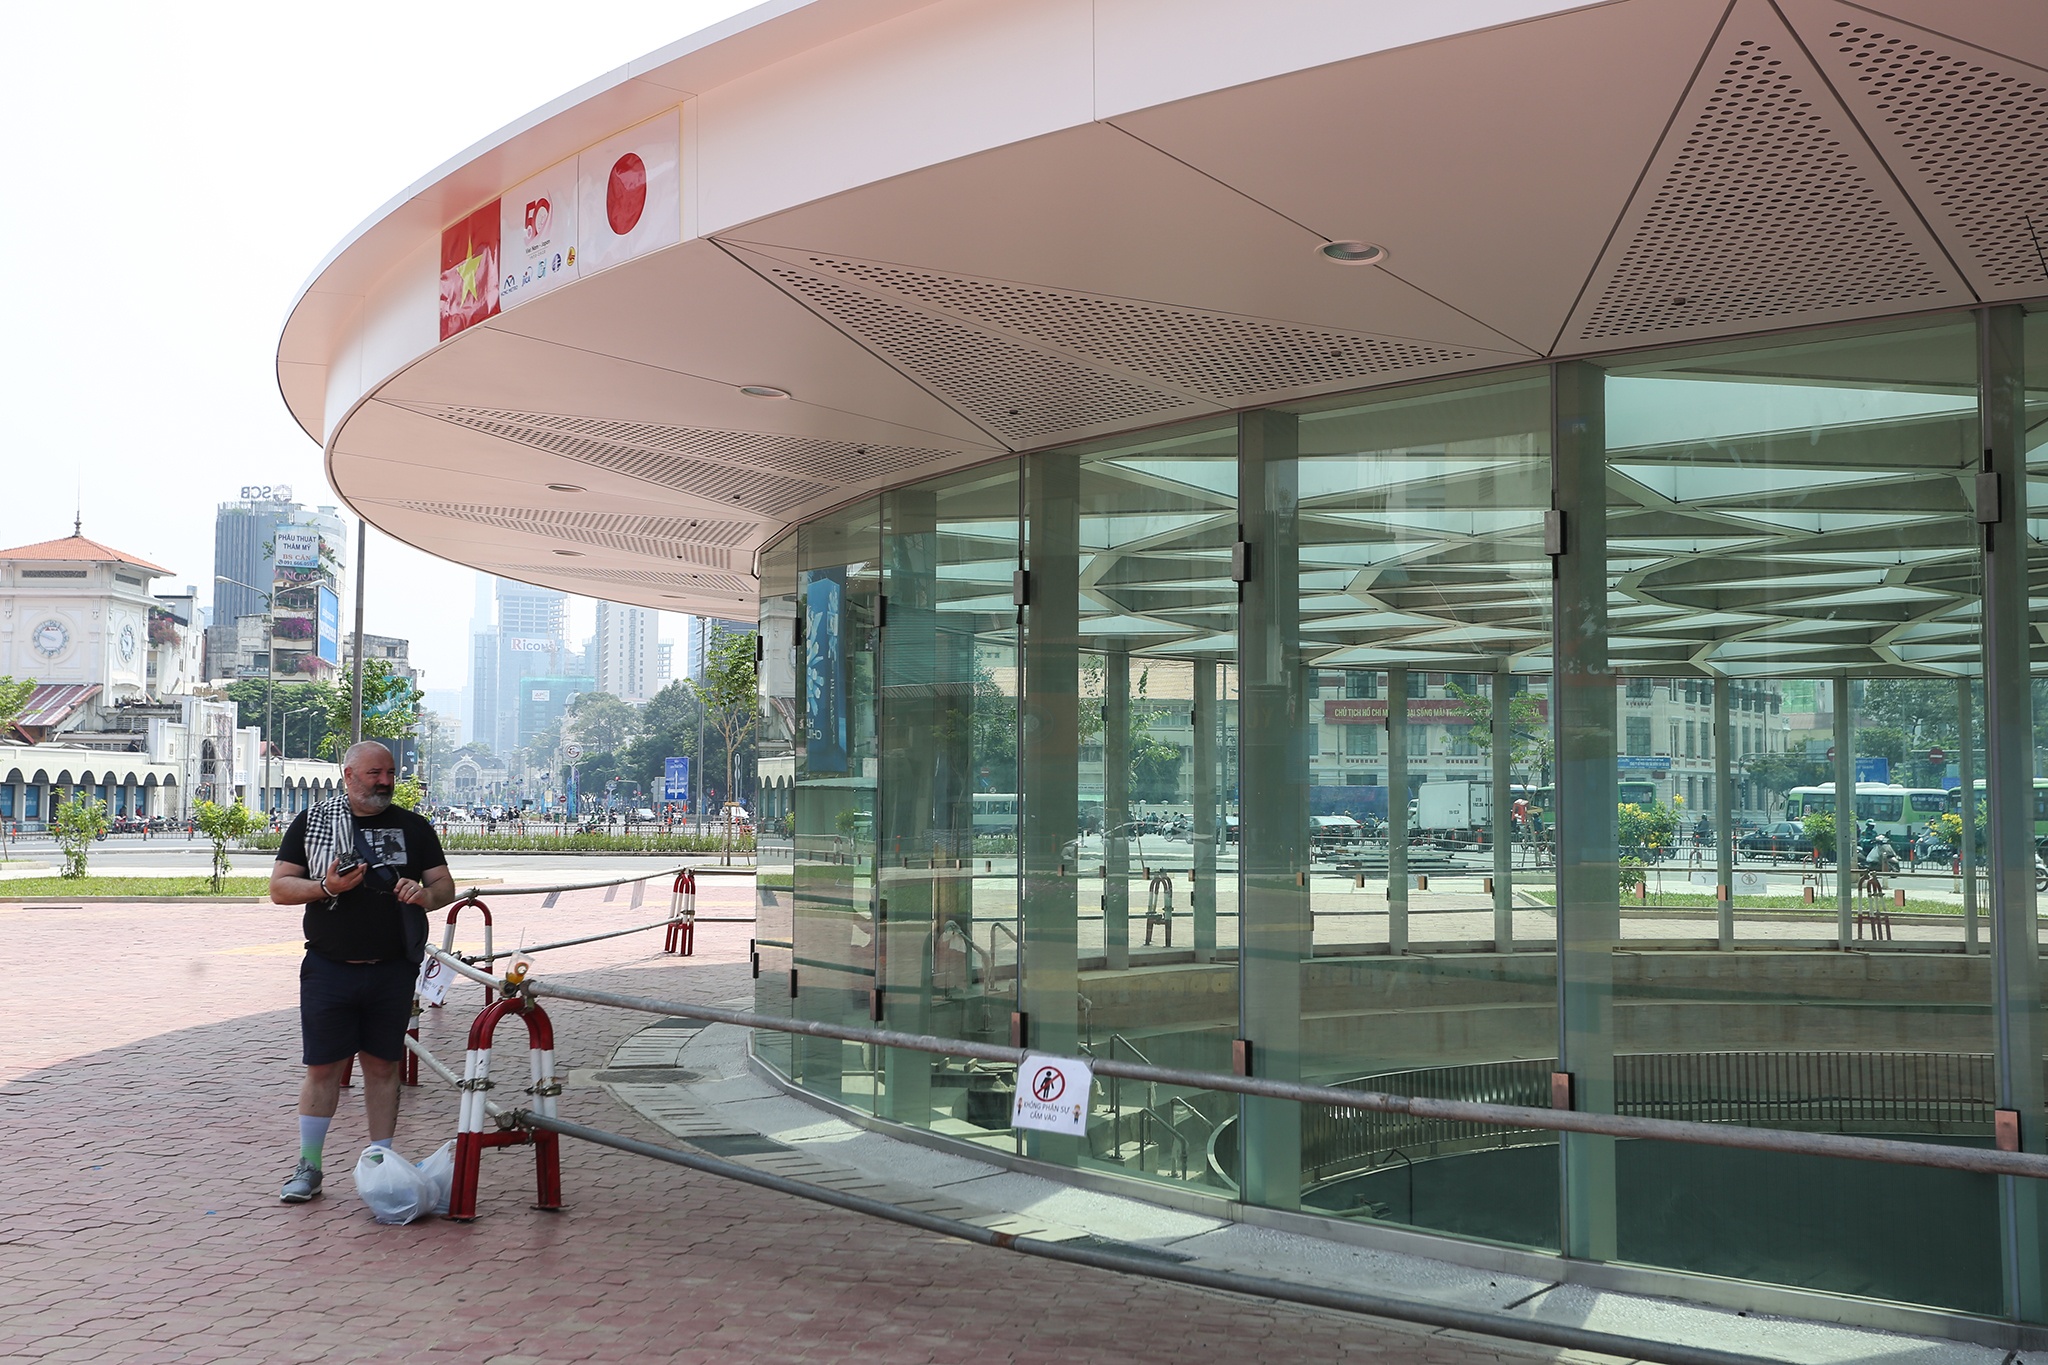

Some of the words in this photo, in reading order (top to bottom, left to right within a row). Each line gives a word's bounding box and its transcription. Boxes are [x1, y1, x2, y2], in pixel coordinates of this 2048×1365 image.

[1334, 706, 1347, 717] CHỦ
[1348, 708, 1361, 718] TỊCH
[1371, 707, 1381, 717] CHÍ
[1024, 1100, 1041, 1110] KHÔNG
[1044, 1112, 1057, 1122] VÀO
